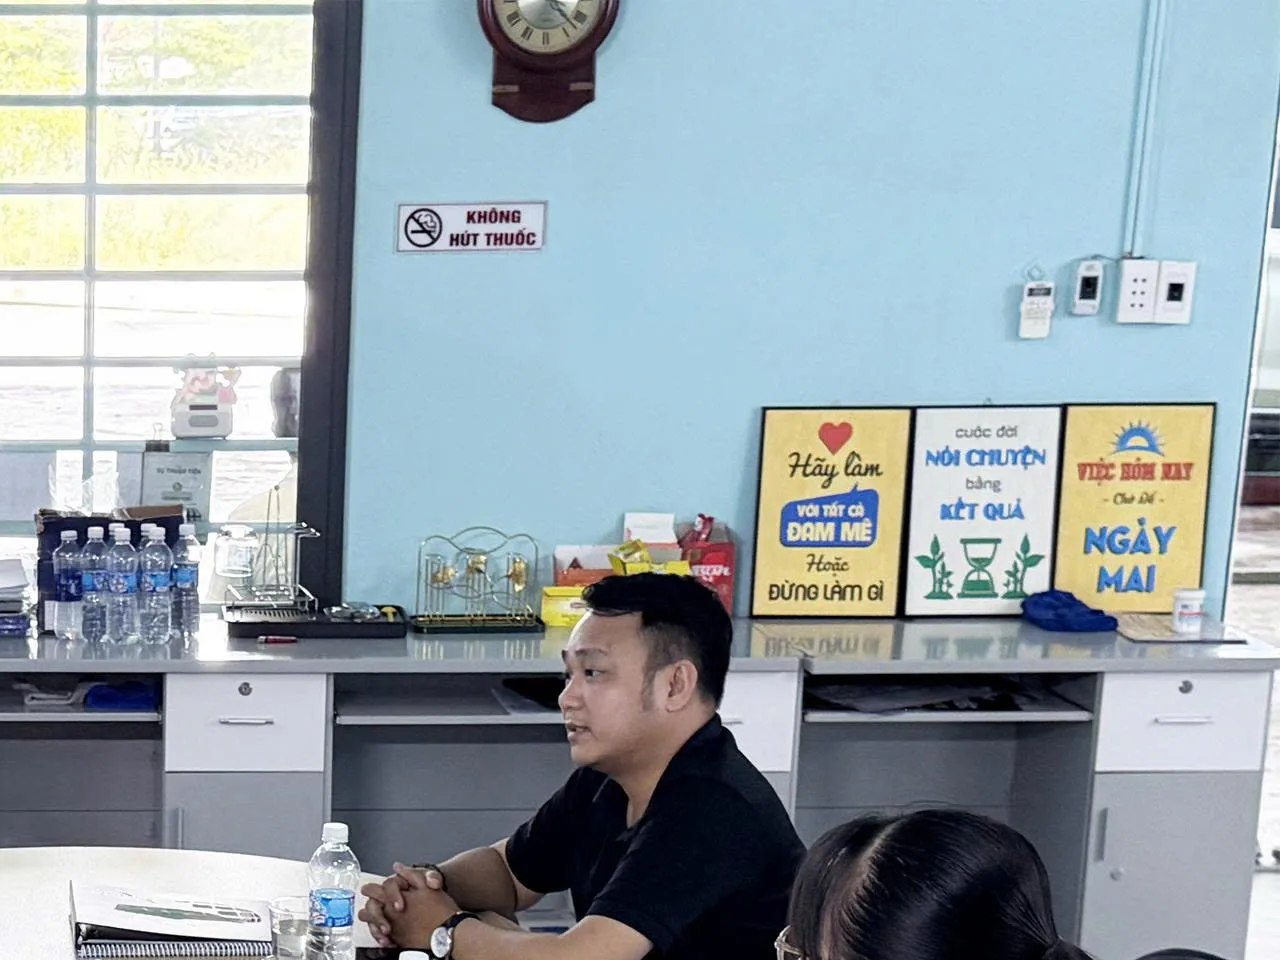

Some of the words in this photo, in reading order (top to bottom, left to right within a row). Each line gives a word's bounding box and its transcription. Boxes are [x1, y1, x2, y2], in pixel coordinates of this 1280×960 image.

[466, 207, 522, 224] KHÔNG
[449, 230, 479, 247] HÚT
[484, 227, 536, 246] THUỐC
[925, 445, 961, 466] NÓI
[789, 452, 838, 489] Hãy
[1077, 457, 1115, 486] VIỆC
[1160, 462, 1194, 481] NAY
[940, 496, 979, 520] KẾT
[983, 498, 1025, 520] QUẢ
[786, 521, 835, 542] ĐAM
[841, 518, 873, 542] MÊ
[1083, 517, 1177, 555] NGÀY
[806, 553, 850, 577] Hoặc
[768, 580, 819, 601] ĐỪNG
[824, 580, 863, 601] LÀM
[868, 580, 884, 601] GÌ
[1096, 564, 1156, 593] MAI
